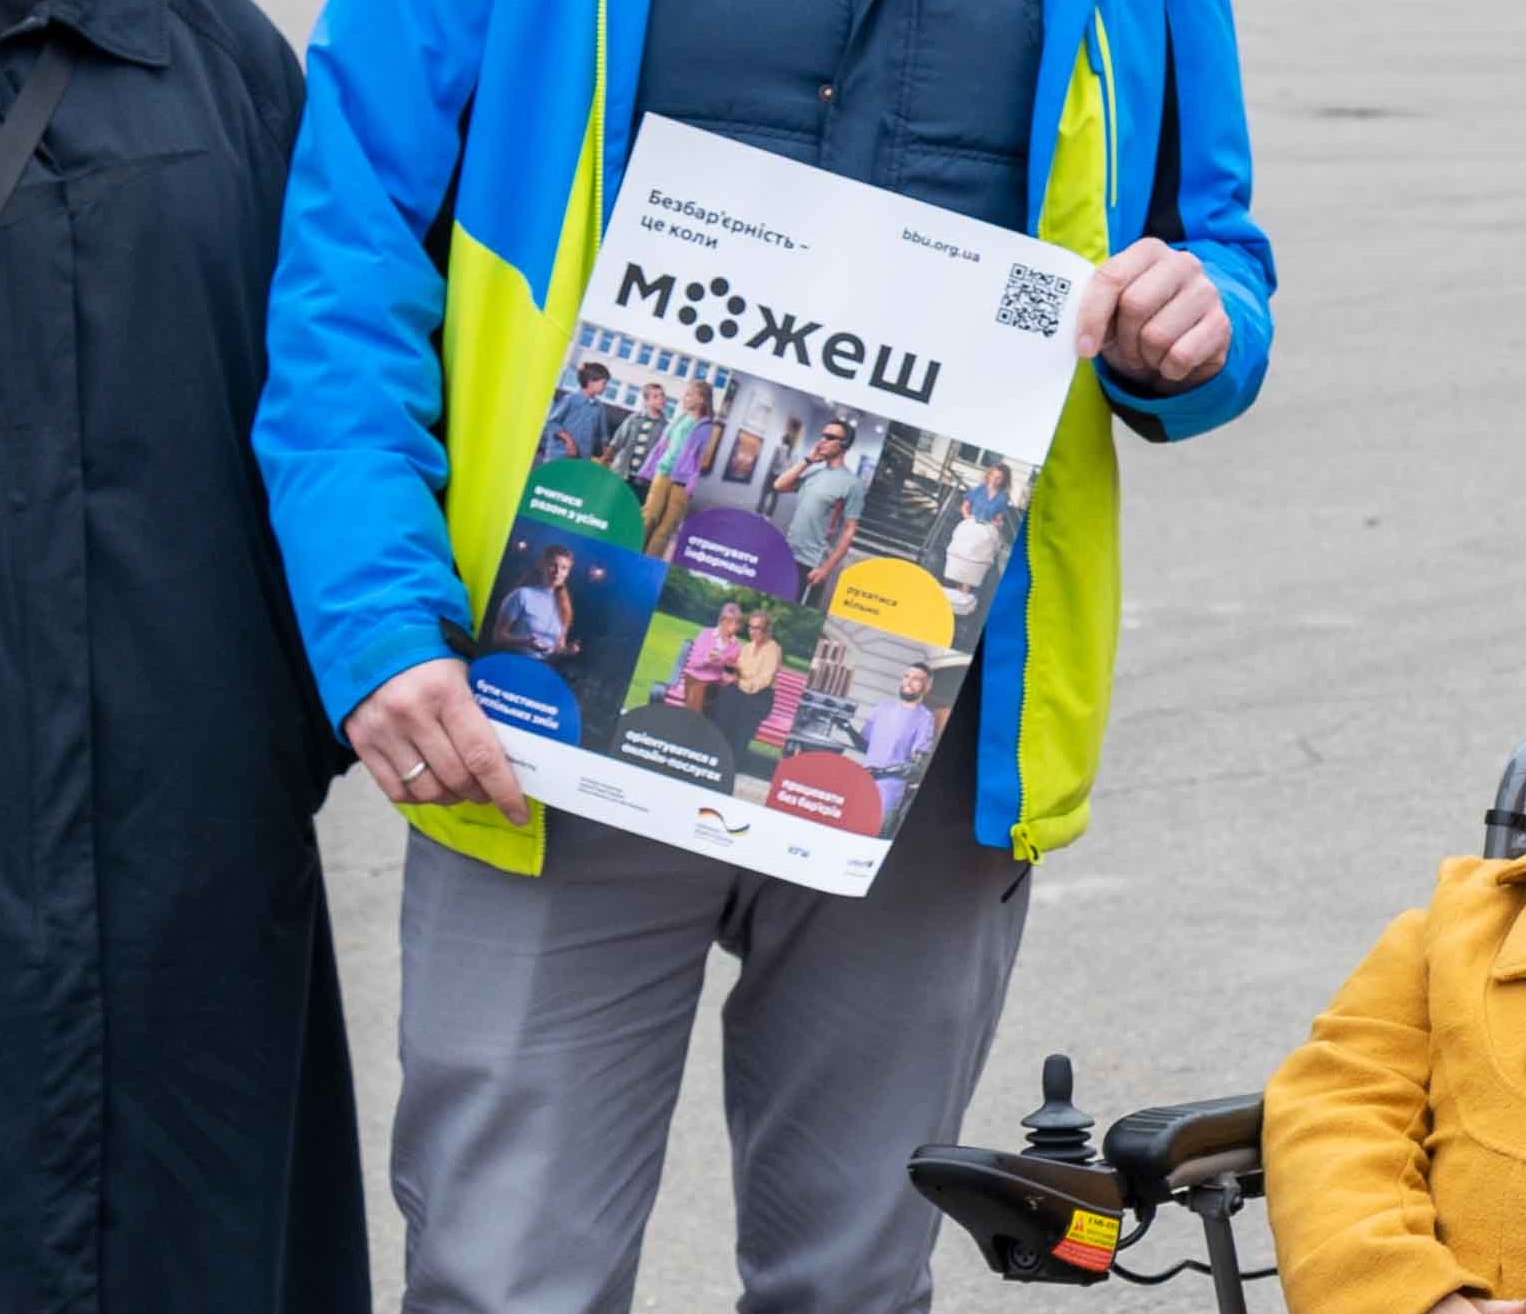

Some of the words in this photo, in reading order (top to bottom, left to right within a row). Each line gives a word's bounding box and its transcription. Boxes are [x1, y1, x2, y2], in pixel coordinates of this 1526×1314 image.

[640, 214, 666, 233] це
[668, 223, 719, 250] коли
[647, 189, 795, 250] Безбар’єрність
[902, 226, 981, 263] bbu.org.ua
[615, 261, 942, 405] можеш
[684, 546, 757, 578] інформацію
[688, 535, 760, 565] отримувати
[846, 586, 898, 607] рухатися
